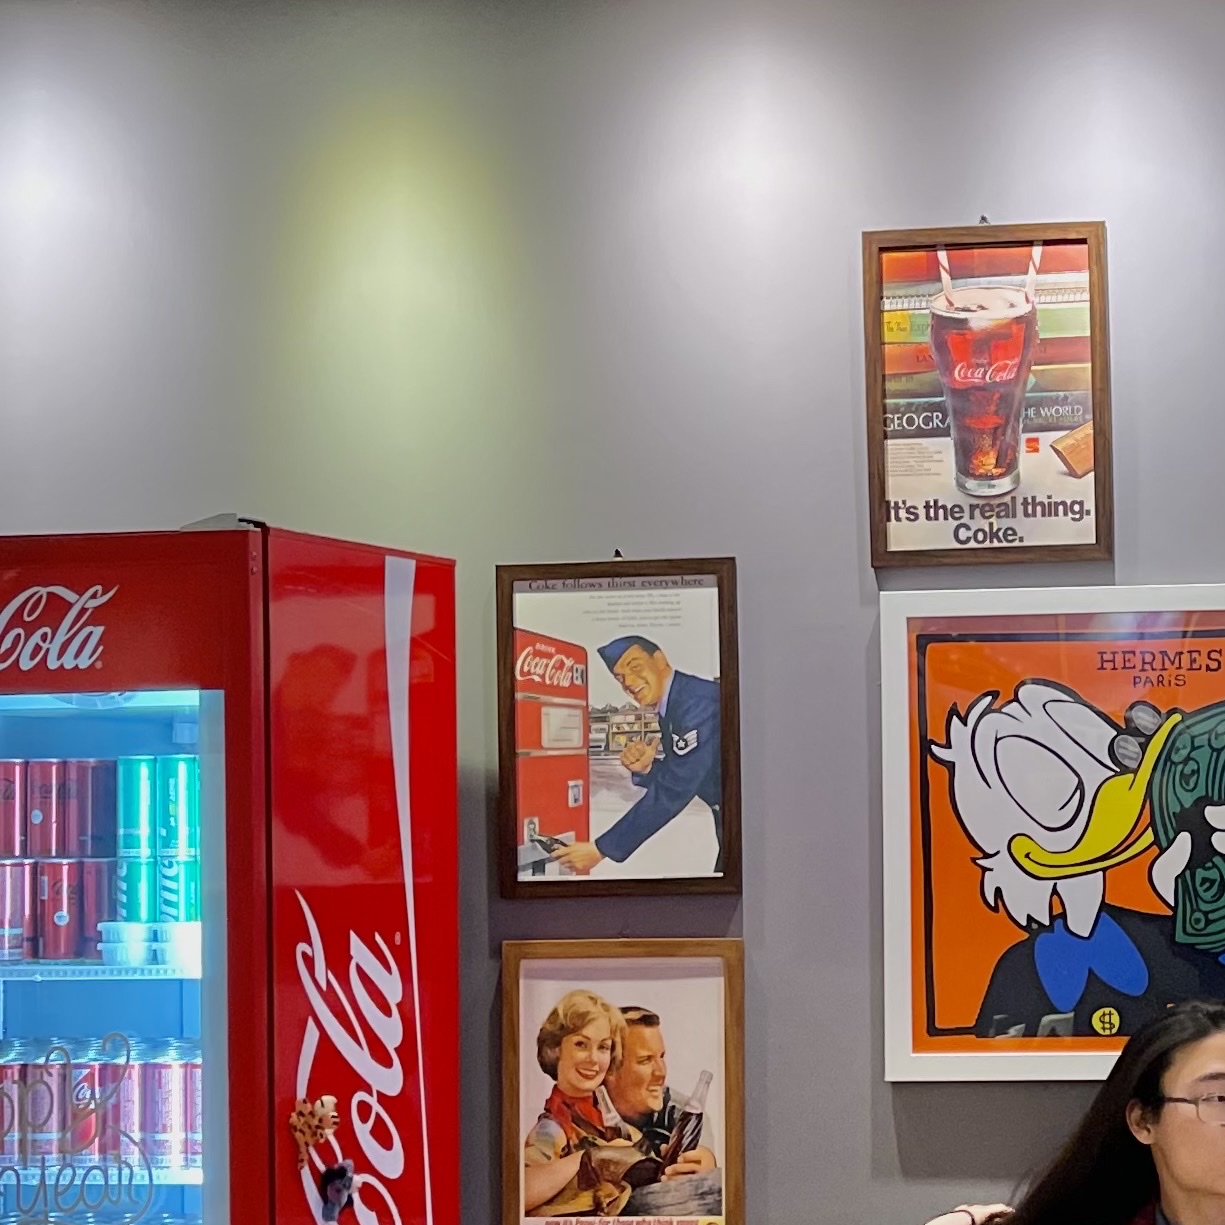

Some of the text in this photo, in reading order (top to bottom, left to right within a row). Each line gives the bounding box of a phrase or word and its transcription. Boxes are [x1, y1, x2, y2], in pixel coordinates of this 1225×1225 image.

[1023, 405, 1083, 418] HE WORLD
[886, 494, 1092, 523] It's the real thing.
[953, 521, 1025, 545] Coke.
[528, 579, 558, 591] Coke
[562, 578, 603, 590] follows
[641, 576, 704, 589] everywhere
[1096, 648, 1224, 674] HERMES
